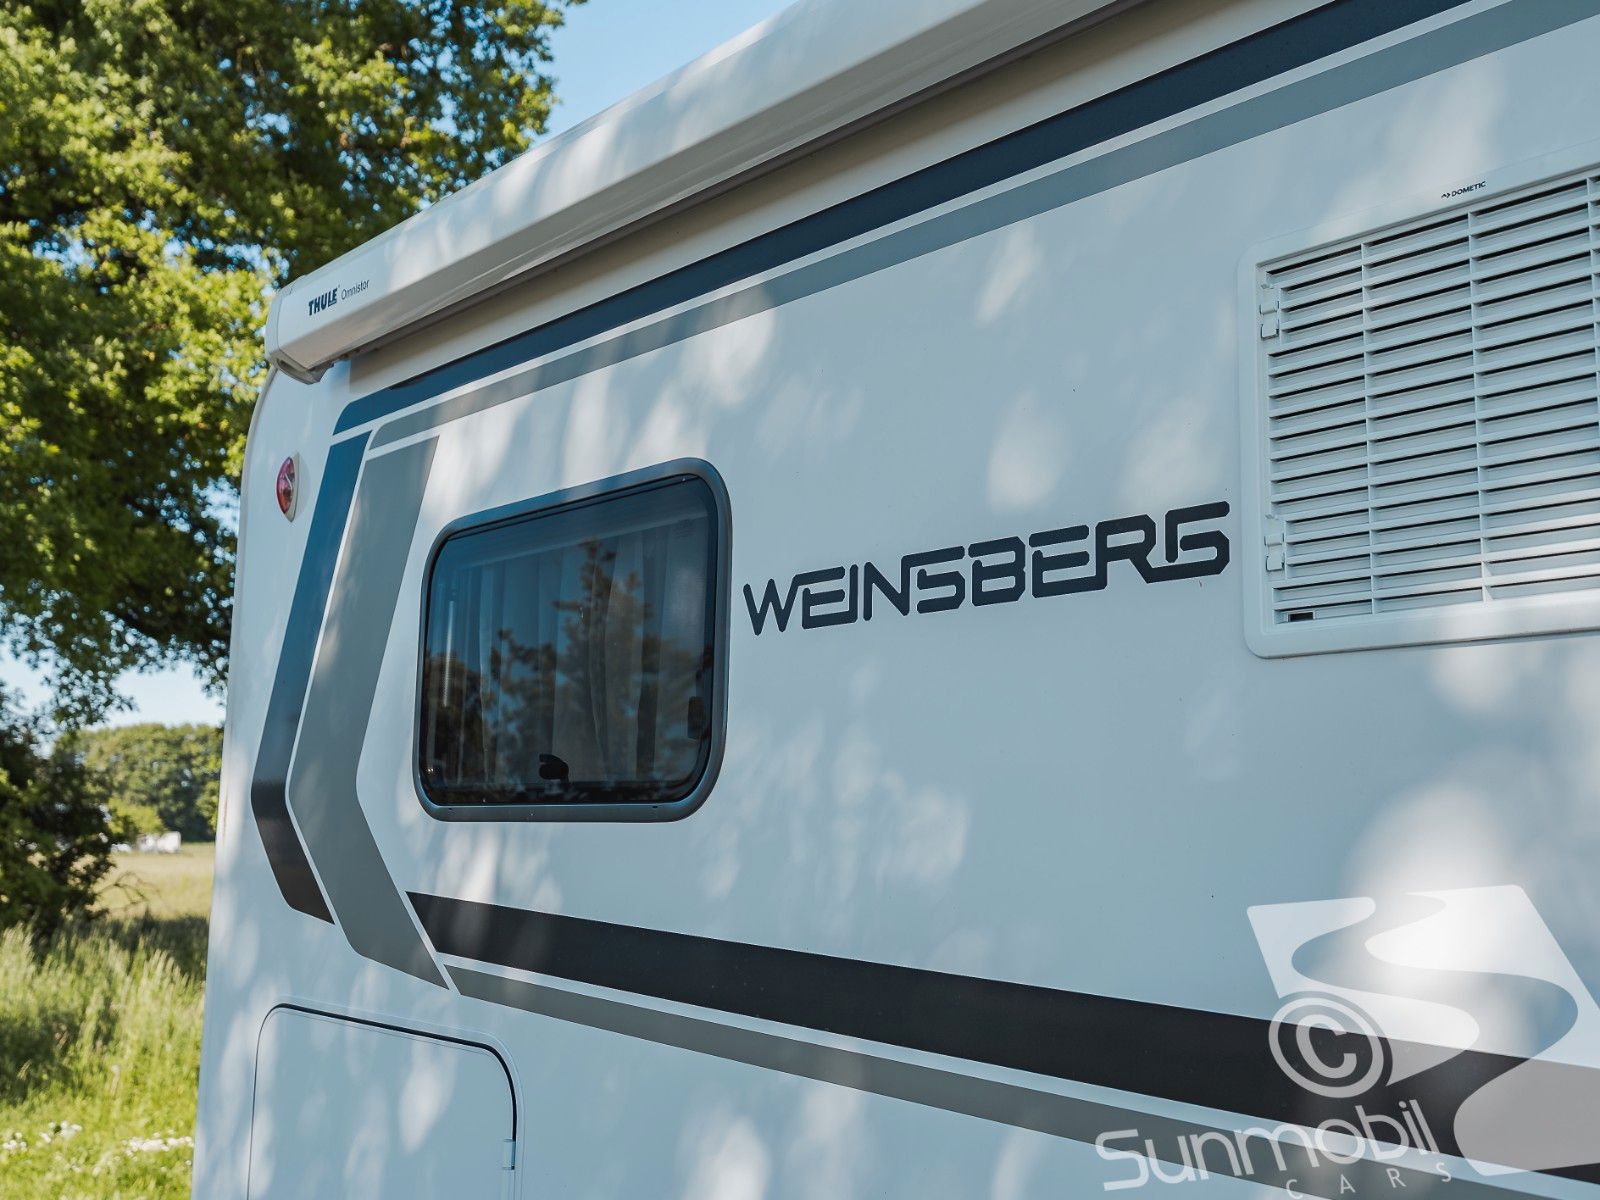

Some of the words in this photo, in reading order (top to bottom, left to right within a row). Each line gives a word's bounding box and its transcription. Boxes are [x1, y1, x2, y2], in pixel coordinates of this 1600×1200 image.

[1451, 180, 1486, 197] DOMETIC
[308, 287, 338, 316] THULE
[341, 279, 370, 300] Omnistor
[743, 500, 1231, 636] WEINSBERG
